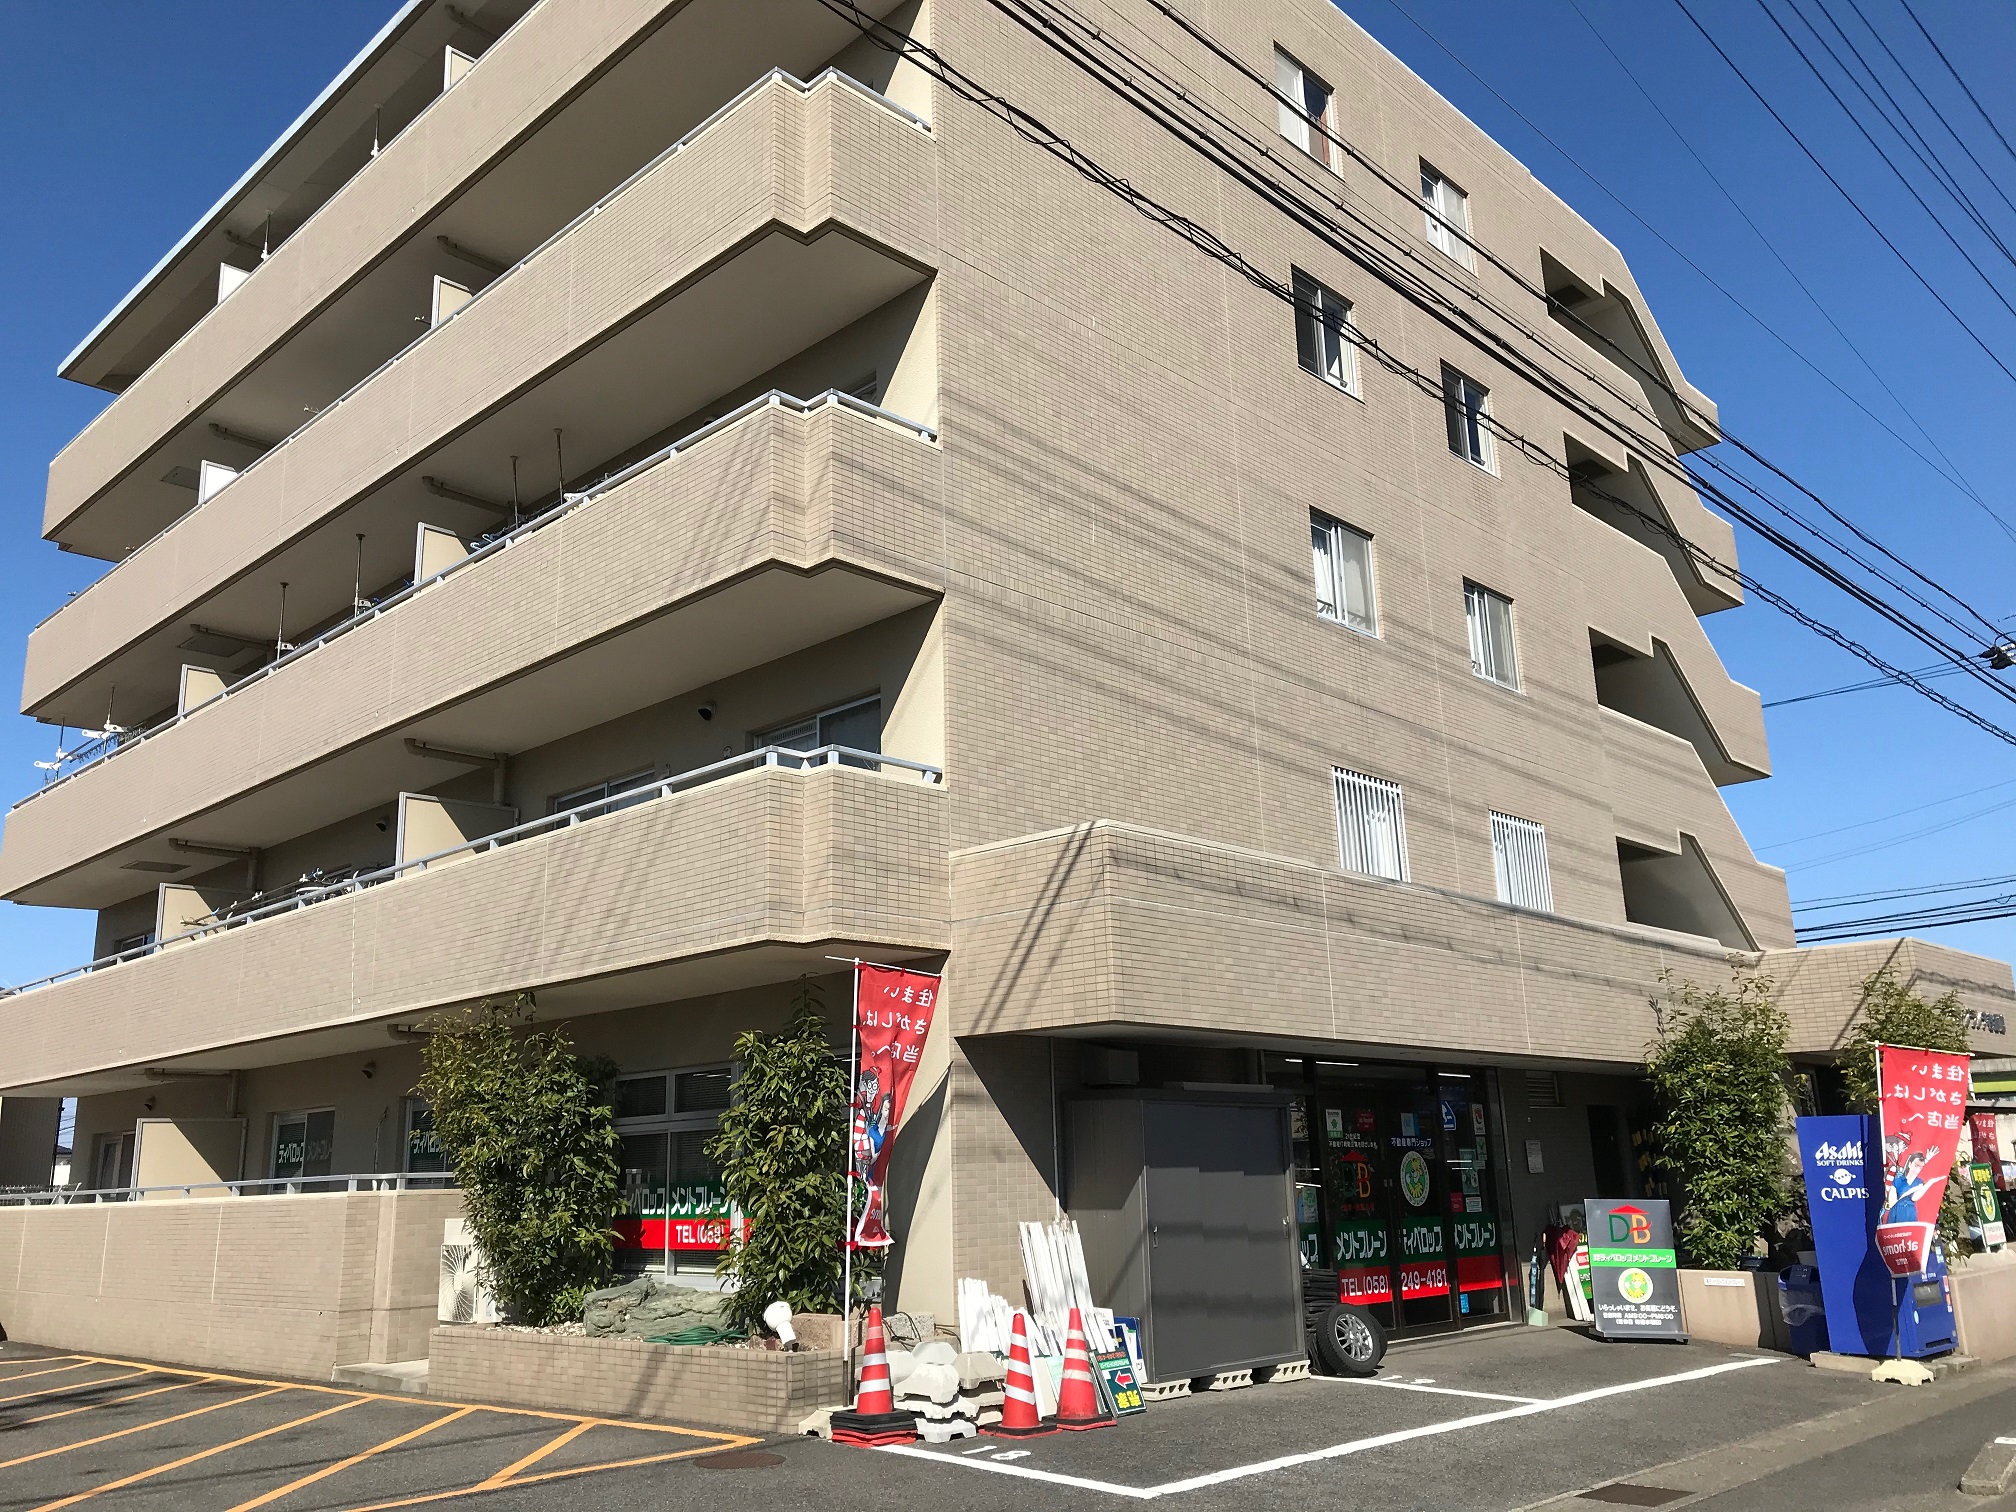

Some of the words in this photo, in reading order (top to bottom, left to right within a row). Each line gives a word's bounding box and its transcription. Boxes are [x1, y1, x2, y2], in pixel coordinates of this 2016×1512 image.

[1815, 1140, 1864, 1160] Asahi
[1817, 1159, 1836, 1167] SOFT
[1836, 1159, 1864, 1167] DRINKS
[1821, 1187, 1870, 1202] CALPIS
[1608, 1213, 1652, 1245] DB
[1400, 1268, 1448, 1291] 249-4181
